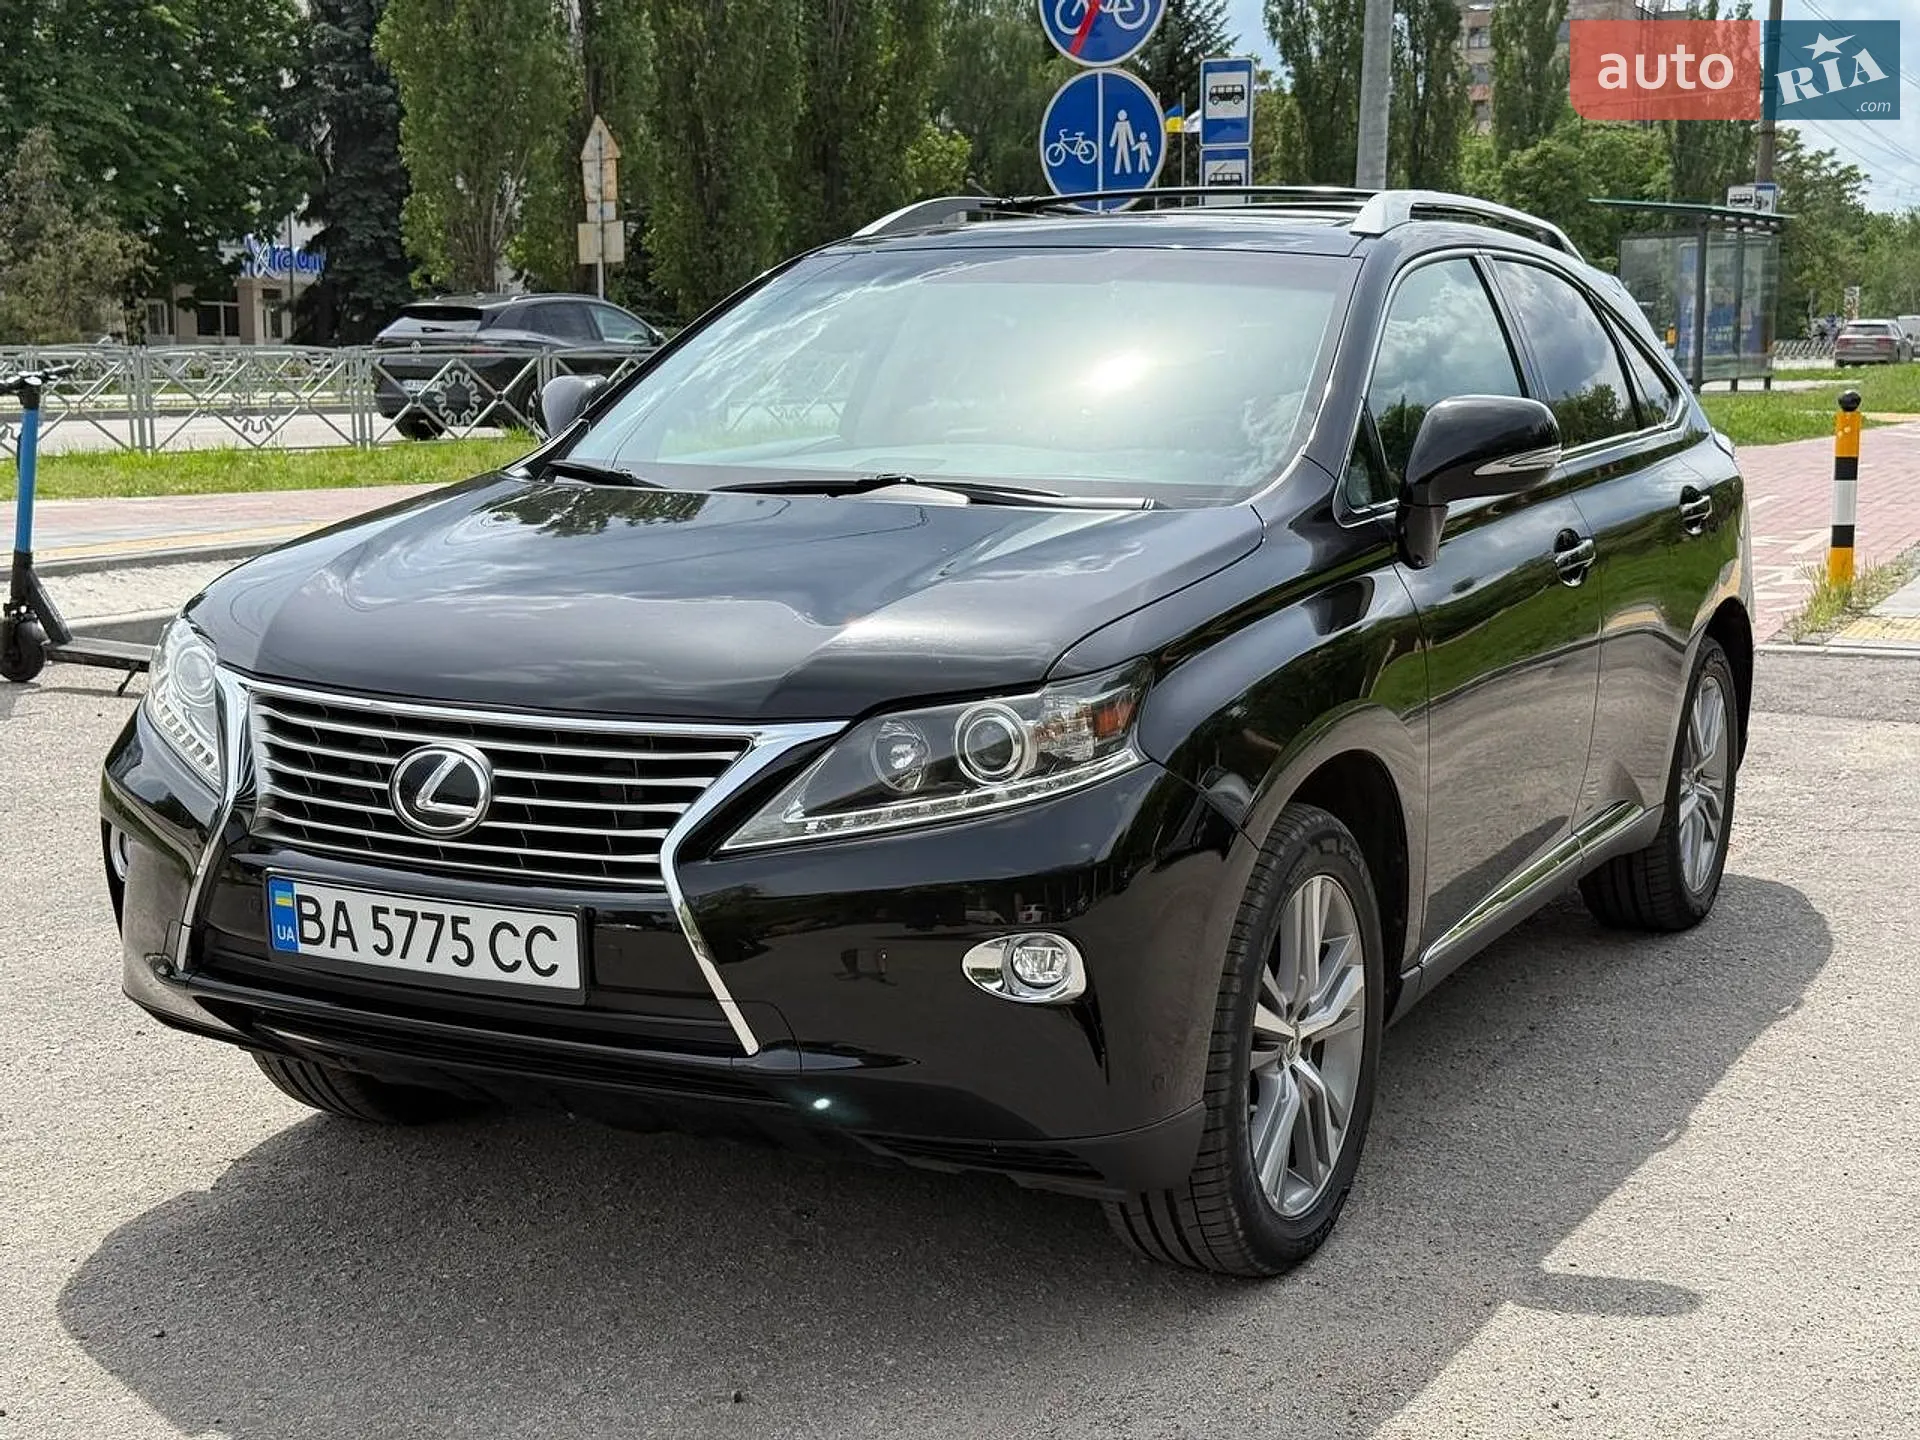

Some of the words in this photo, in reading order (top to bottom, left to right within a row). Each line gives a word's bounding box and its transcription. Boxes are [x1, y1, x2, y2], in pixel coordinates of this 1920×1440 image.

[277, 924, 296, 943] UA
[296, 894, 358, 952] BA
[371, 905, 475, 967] 5775
[489, 921, 559, 977] CC
